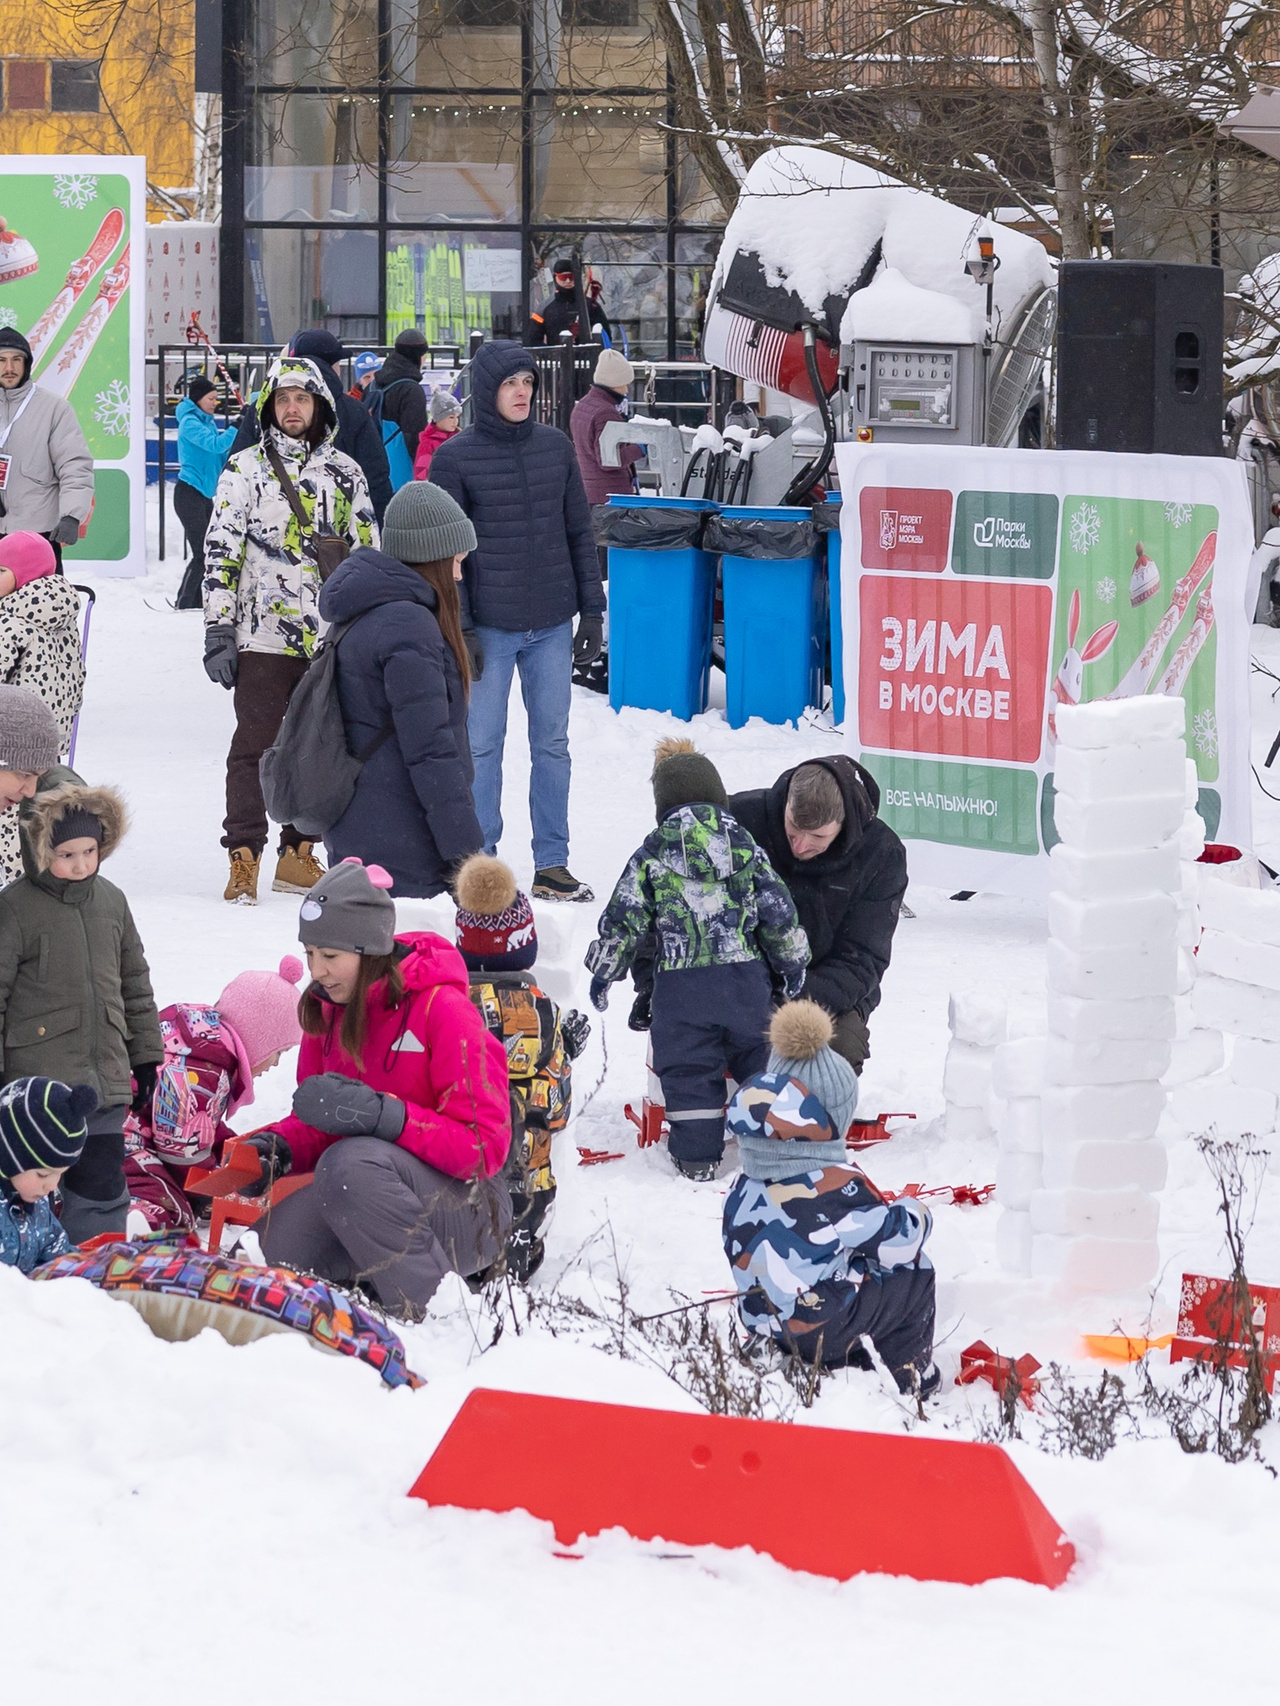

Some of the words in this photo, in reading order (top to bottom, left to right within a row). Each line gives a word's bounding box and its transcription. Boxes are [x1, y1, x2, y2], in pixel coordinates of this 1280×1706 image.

[899, 515, 923, 524] ПРОЕКТ
[996, 518, 1026, 536] Парки
[898, 534, 924, 544] МОСКВЫ
[995, 534, 1031, 549] Москвы
[879, 616, 1011, 680] ЗИМА
[879, 680, 893, 710] В
[900, 683, 1010, 721] МОСКВЕ
[886, 789, 912, 807] ВСЕ
